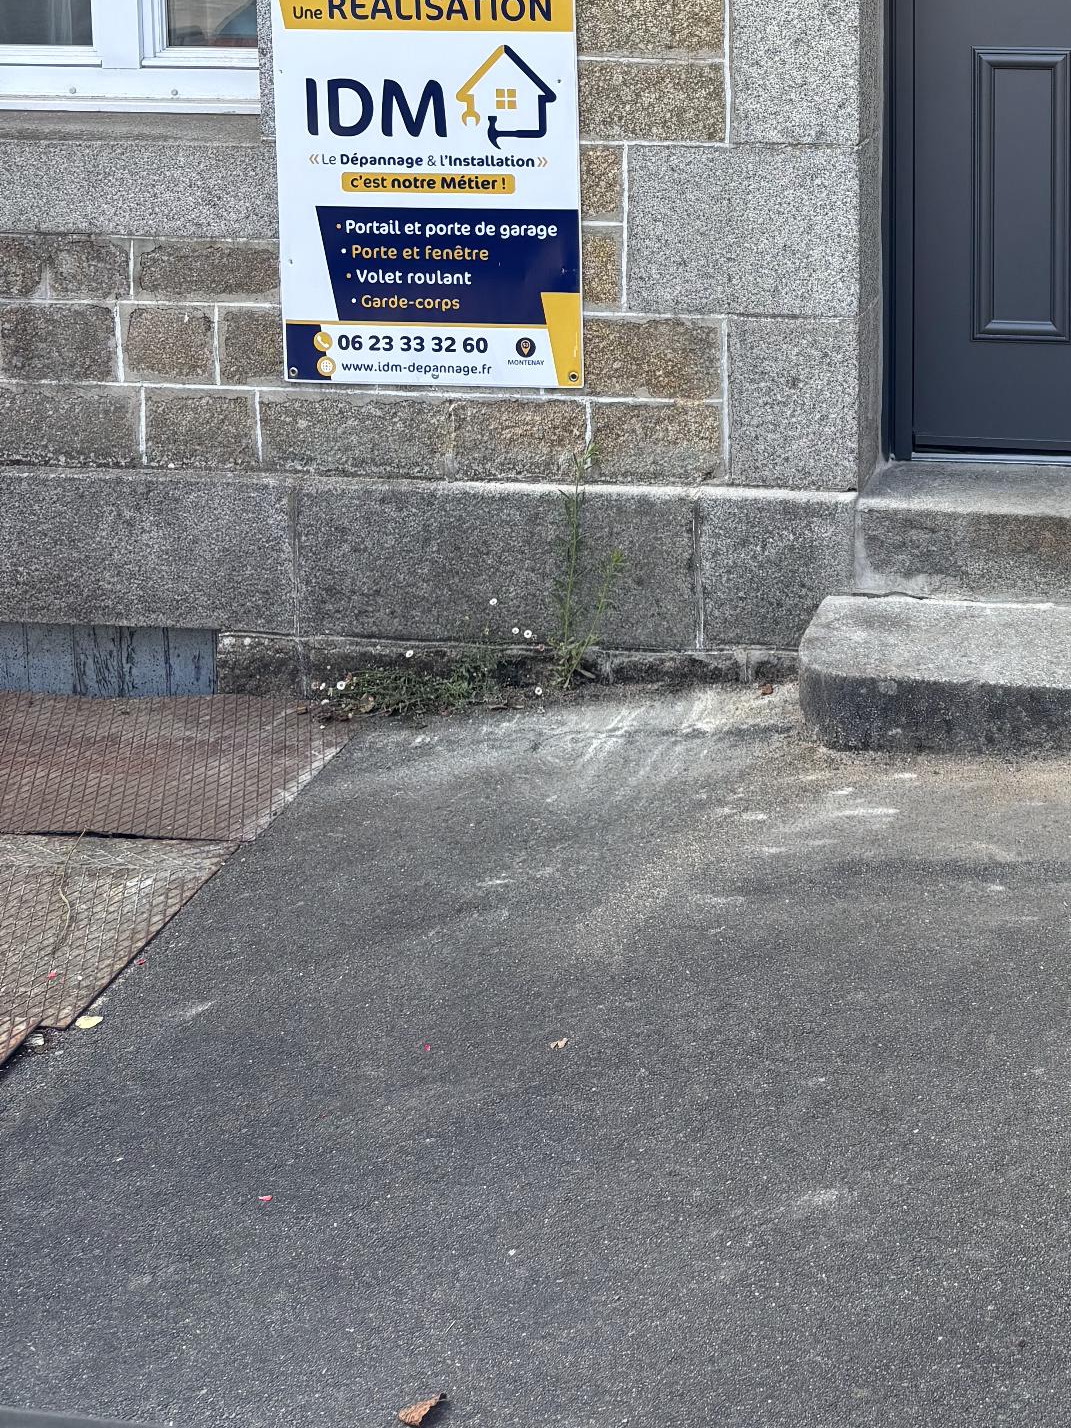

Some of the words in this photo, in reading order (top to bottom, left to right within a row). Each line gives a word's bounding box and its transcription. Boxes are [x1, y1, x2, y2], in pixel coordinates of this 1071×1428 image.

[293, 6, 322, 19] Une
[305, 78, 448, 137] IDM
[322, 154, 336, 165] Le
[340, 154, 423, 168] Dépannage
[427, 155, 436, 166] &
[391, 177, 436, 189] notre
[441, 175, 498, 190] Métier
[345, 220, 400, 235] Portail
[406, 222, 421, 235] et
[425, 223, 471, 238] porte
[475, 222, 496, 236] de
[500, 225, 557, 239] garage
[351, 245, 397, 259] Porte
[402, 247, 420, 259] et
[425, 246, 489, 261] fenêtre
[356, 269, 402, 284] Volet
[407, 270, 472, 285] roulant
[361, 295, 460, 310] Garde-corps
[338, 335, 363, 351] 06
[369, 335, 393, 352] 23
[400, 336, 425, 352] 33
[431, 337, 457, 353] 32
[462, 337, 488, 353] 60
[341, 361, 492, 375] www.idm-depannage.fr
